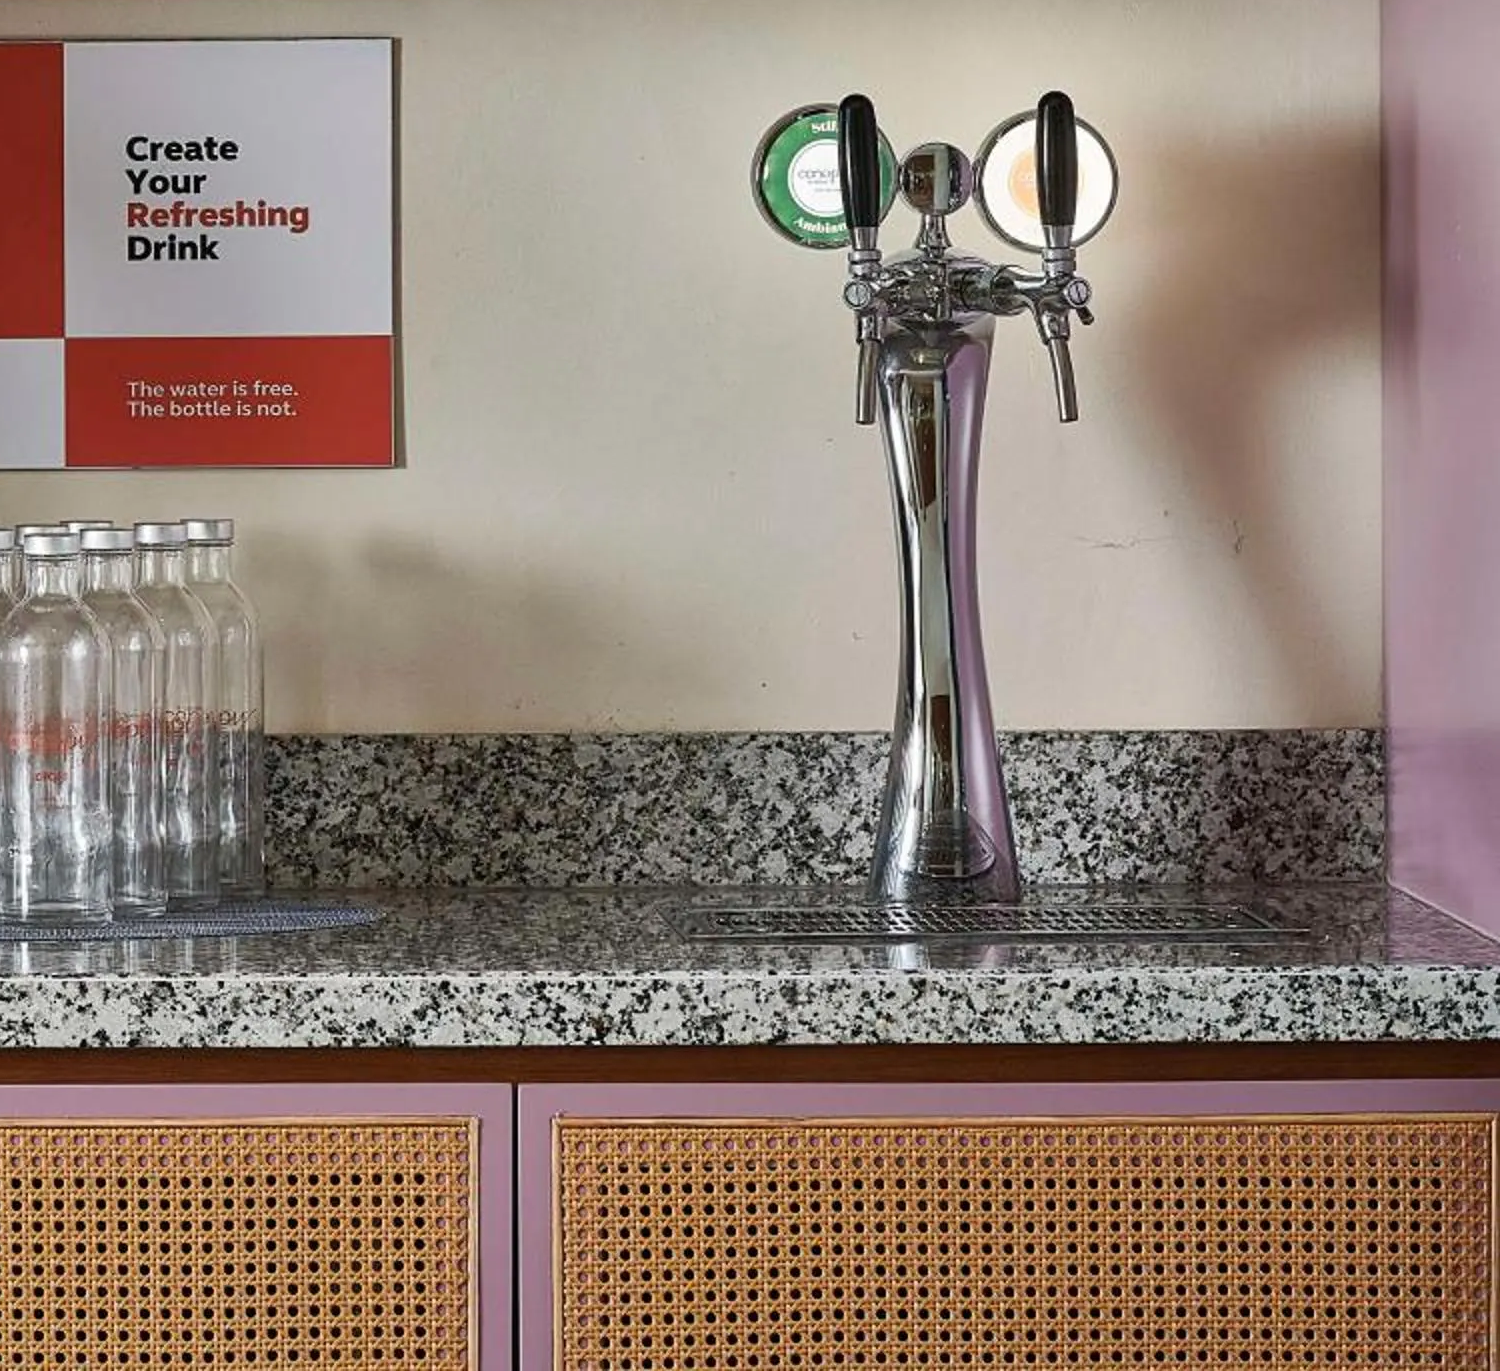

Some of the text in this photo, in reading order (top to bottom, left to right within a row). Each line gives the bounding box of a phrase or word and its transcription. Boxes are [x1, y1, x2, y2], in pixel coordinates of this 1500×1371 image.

[125, 135, 239, 163] Create
[124, 168, 207, 196] Your
[126, 200, 310, 234] Refreshing
[126, 234, 220, 262] Drink
[127, 379, 299, 398] The water is free.
[127, 400, 297, 417] The bottle is not.
